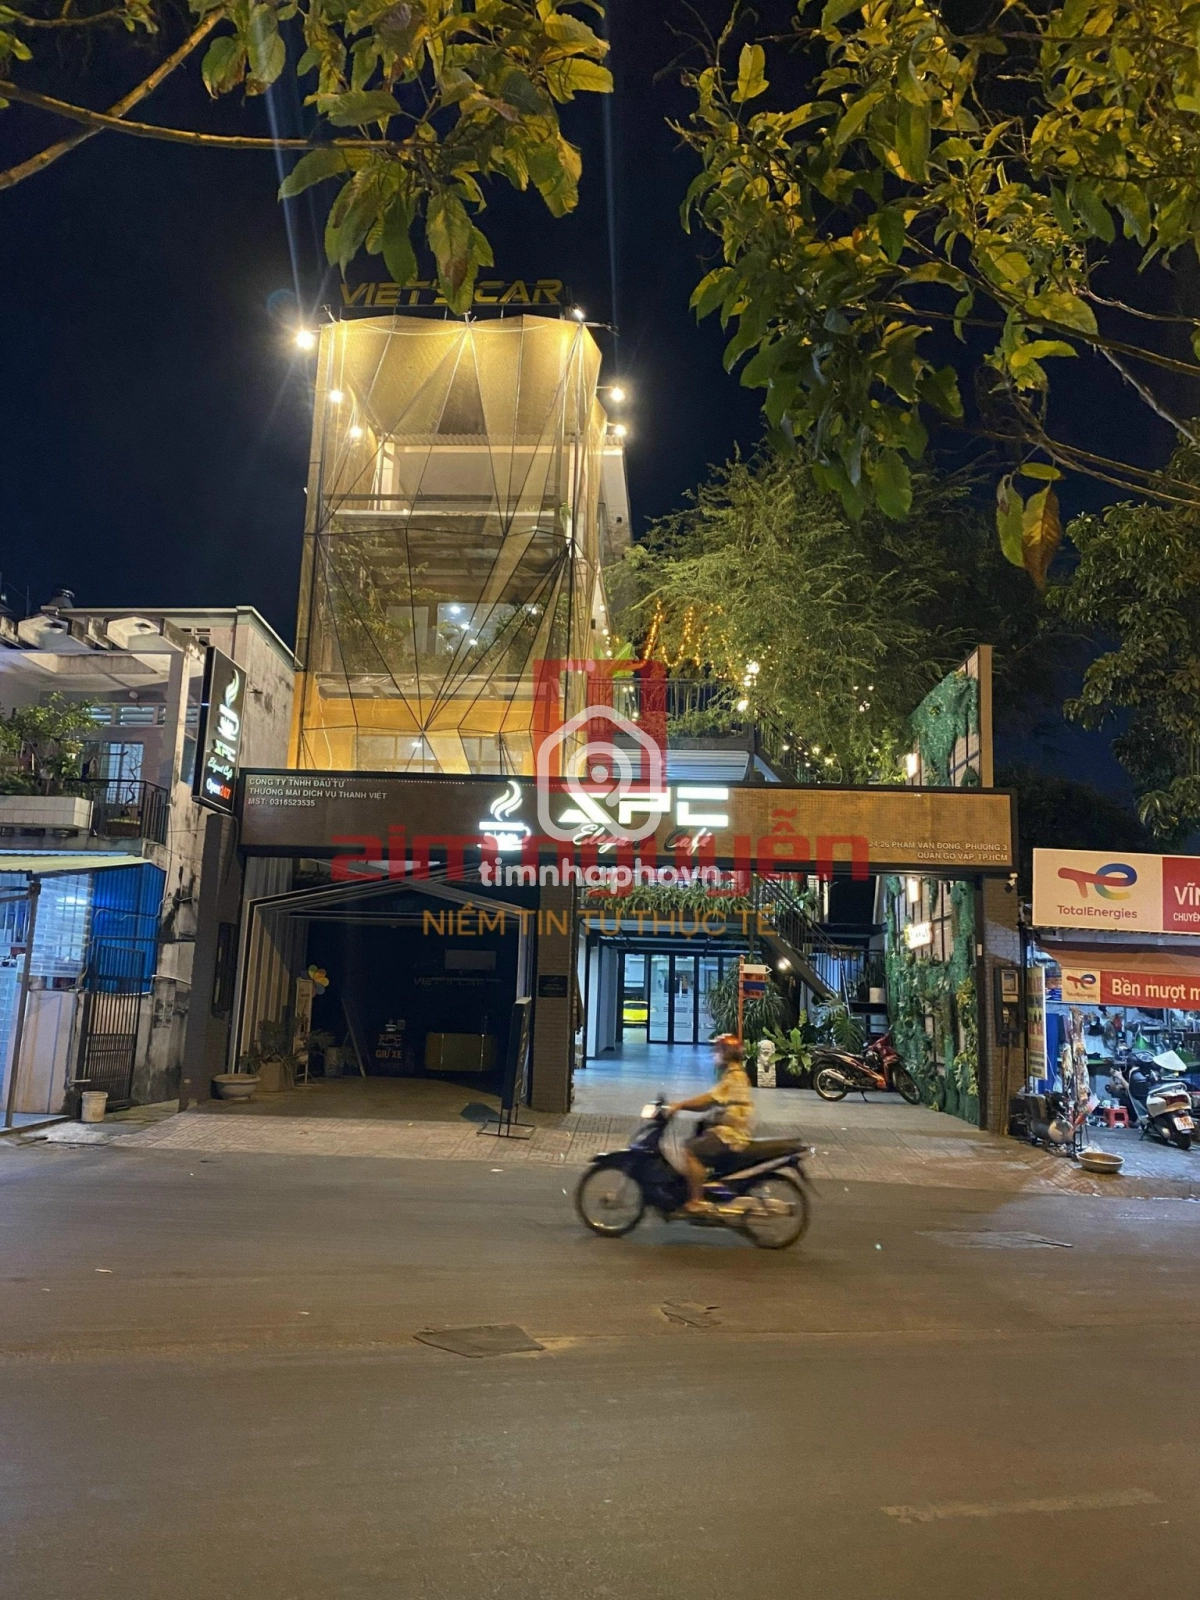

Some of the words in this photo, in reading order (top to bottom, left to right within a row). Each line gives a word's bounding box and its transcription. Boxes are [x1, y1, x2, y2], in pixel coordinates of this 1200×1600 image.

[474, 279, 563, 304] CAR
[276, 778, 288, 786] TY
[289, 779, 312, 787] TNHH
[339, 790, 367, 799] THANH
[573, 824, 653, 853] Elega
[1057, 904, 1138, 920] TotalEnergies
[1173, 911, 1200, 922] CHUYÊ
[1111, 976, 1141, 997] Bền
[1145, 983, 1187, 1003] mượt
